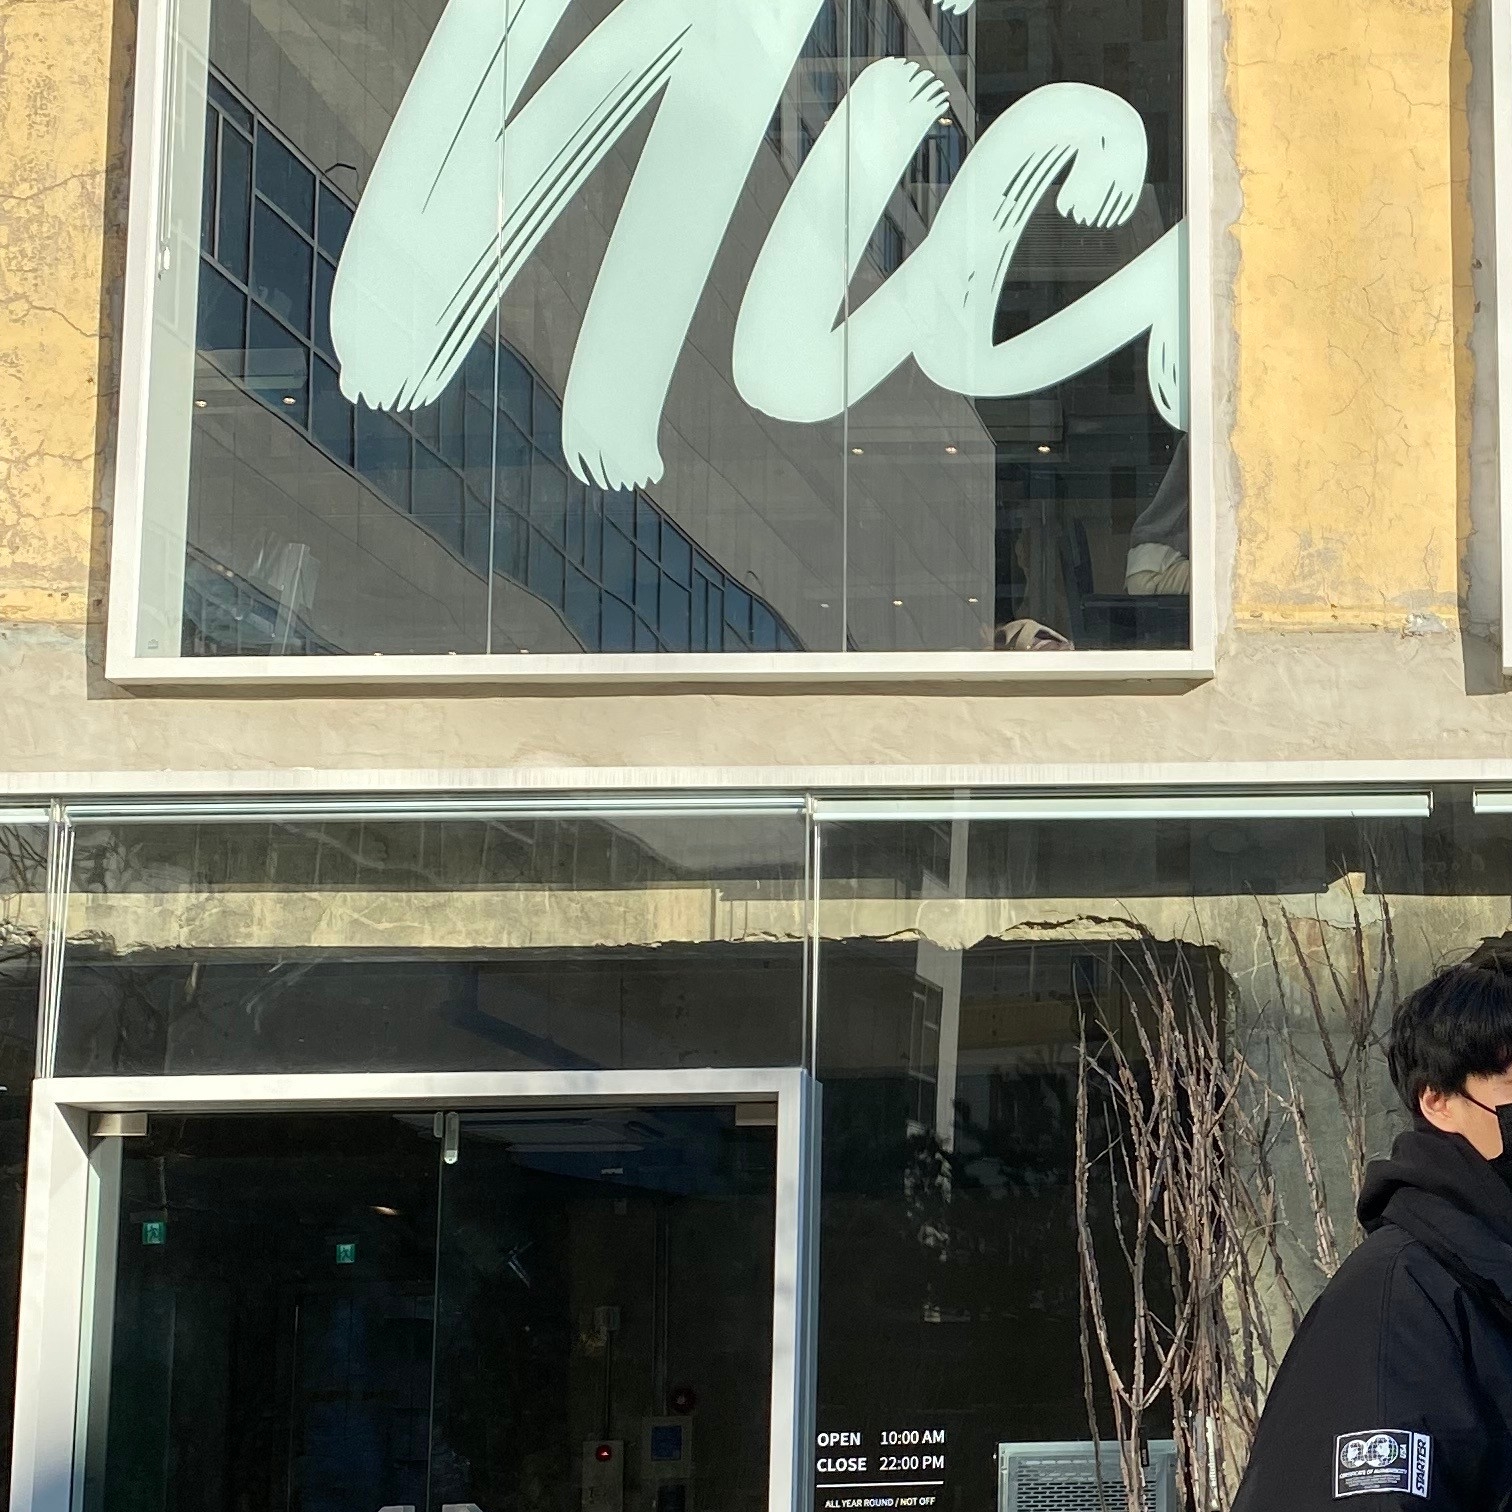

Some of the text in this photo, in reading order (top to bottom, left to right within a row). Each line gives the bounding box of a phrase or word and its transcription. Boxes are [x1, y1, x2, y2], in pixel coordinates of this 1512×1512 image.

[817, 1429, 945, 1447] OPEN 10:00 AM
[816, 1455, 945, 1472] CLOSE 22:00 PM
[1416, 1438, 1427, 1495] STARTER
[825, 1500, 841, 1508] ALL
[841, 1499, 863, 1508] YEAR
[863, 1498, 894, 1507] ROUND
[900, 1497, 917, 1506] NOT
[918, 1497, 936, 1506] OFF
